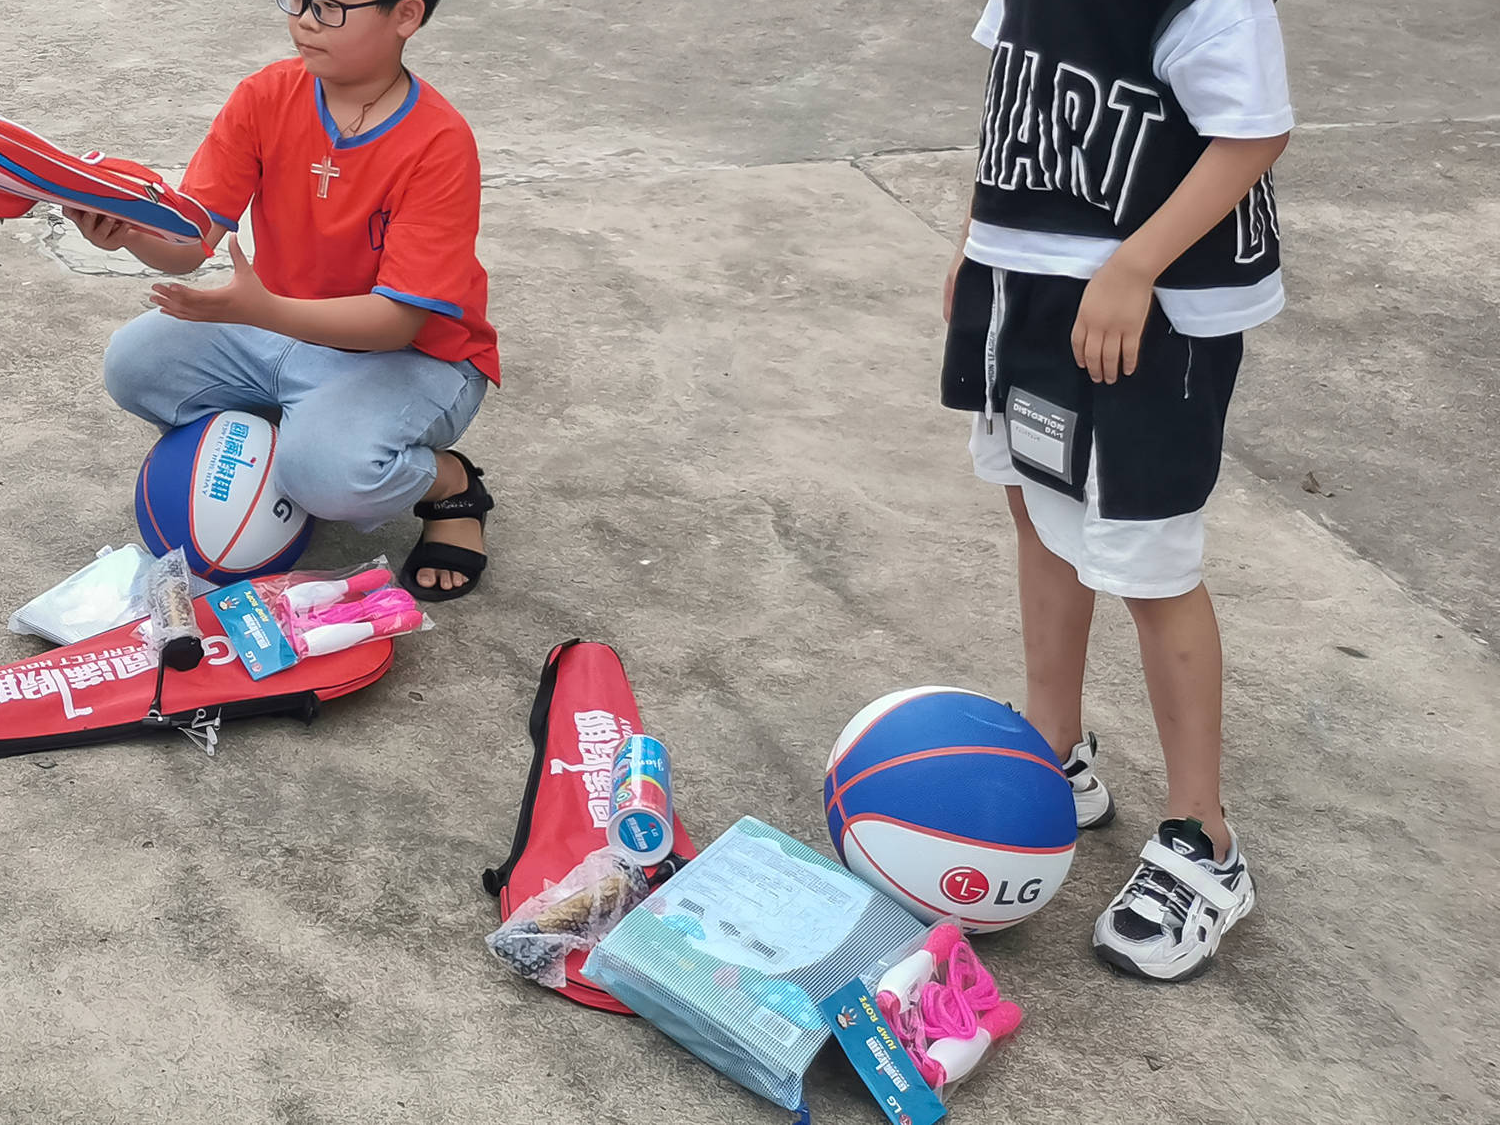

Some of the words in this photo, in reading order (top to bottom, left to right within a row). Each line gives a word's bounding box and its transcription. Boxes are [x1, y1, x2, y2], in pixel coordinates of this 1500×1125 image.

[973, 40, 1166, 227] ART
[52, 641, 149, 669] PERFECT
[994, 878, 1043, 904] LG
[858, 995, 879, 1022] ROPE
[876, 1025, 897, 1050] JUMP
[886, 1095, 902, 1114] LG
